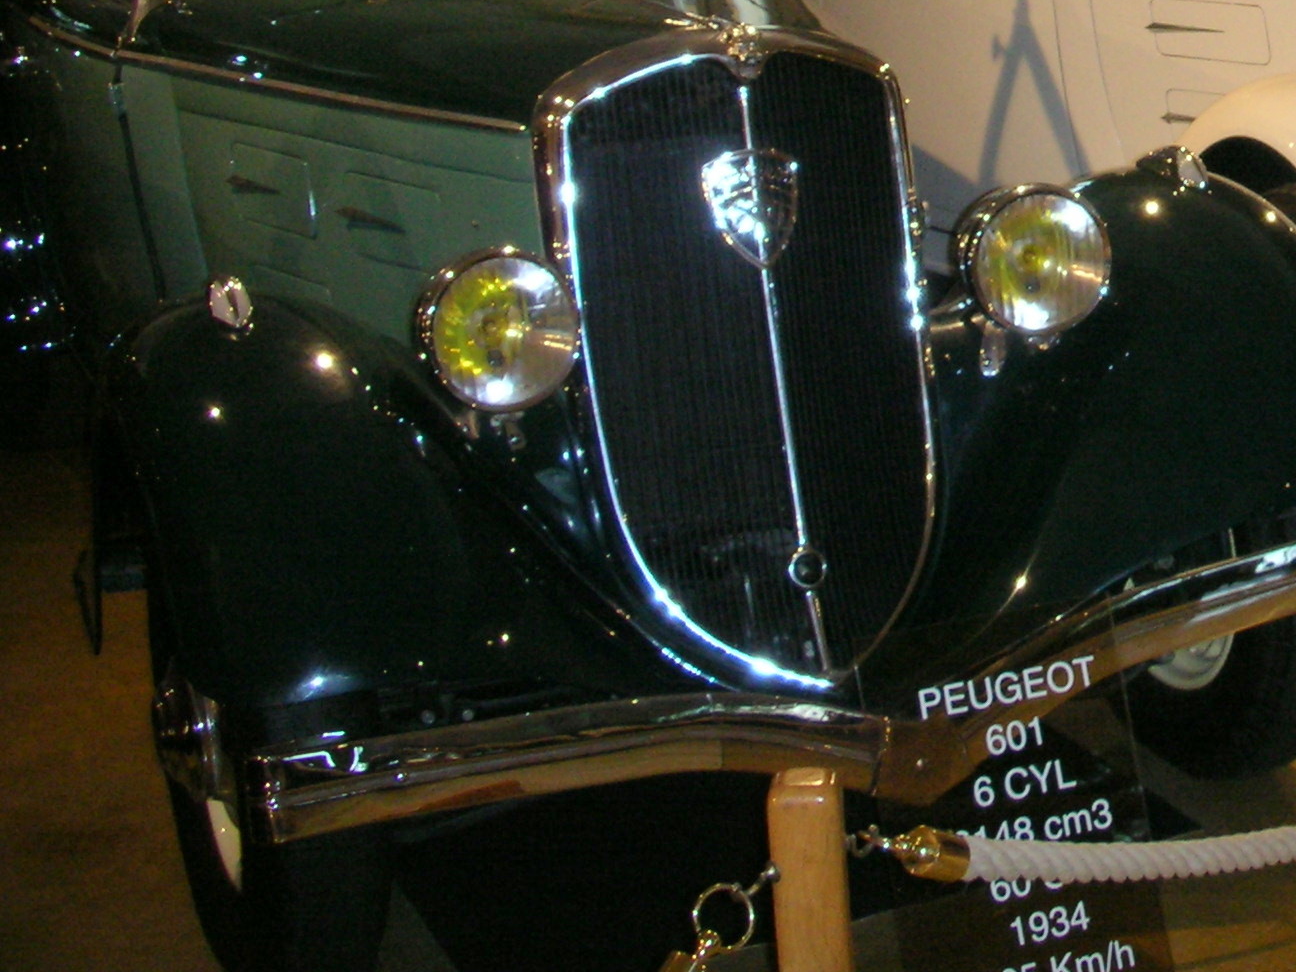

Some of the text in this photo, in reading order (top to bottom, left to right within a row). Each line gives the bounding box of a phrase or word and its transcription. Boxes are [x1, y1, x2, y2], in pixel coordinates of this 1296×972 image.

[918, 655, 1095, 721] PEUGEOT
[986, 716, 1043, 756] 601
[973, 758, 1078, 808] 6 CYL
[1043, 799, 1113, 841] cm3
[1009, 900, 1091, 946] 1934
[1049, 940, 1136, 972] Km/h
